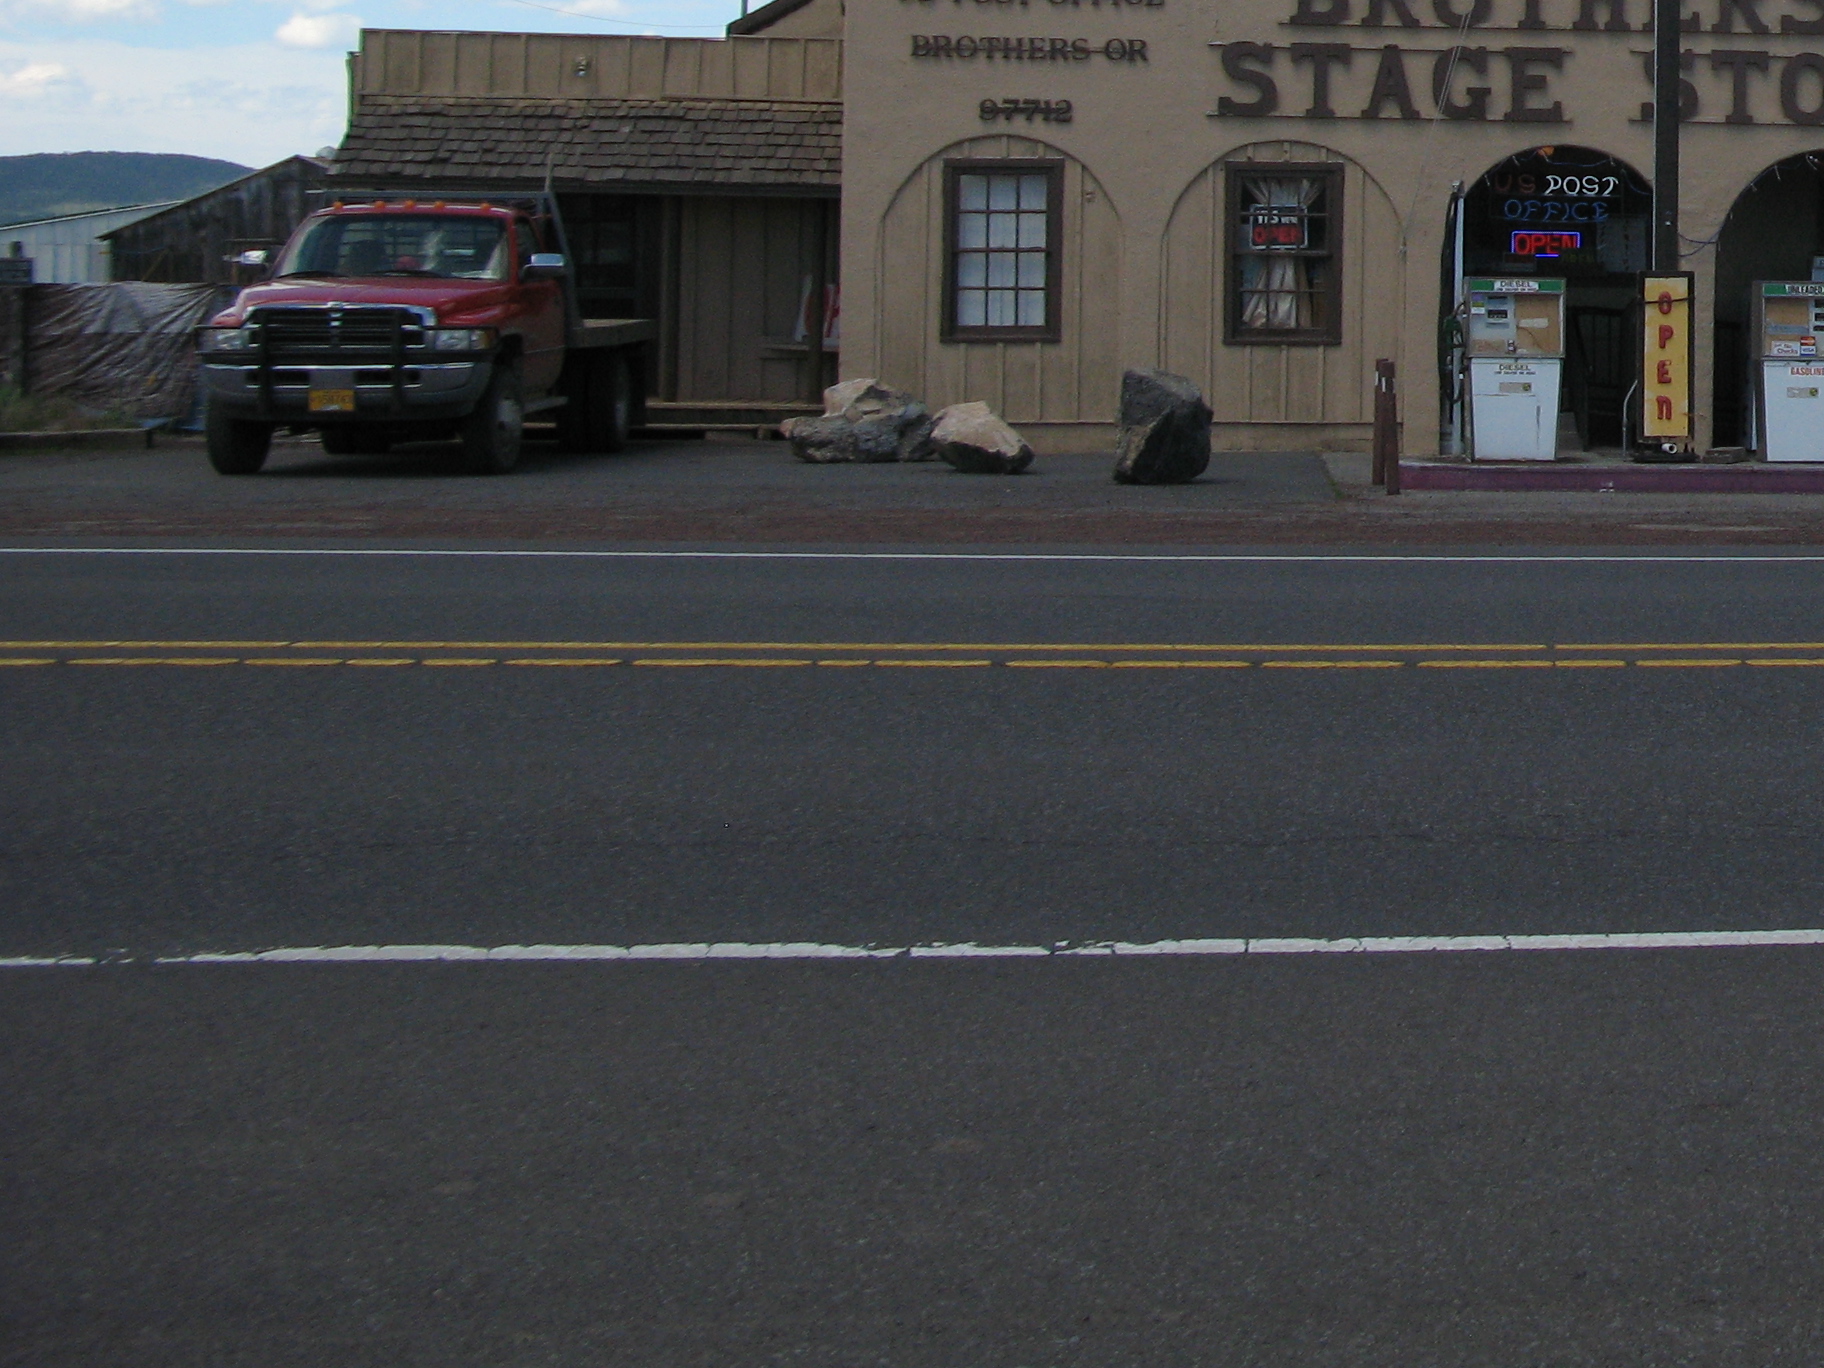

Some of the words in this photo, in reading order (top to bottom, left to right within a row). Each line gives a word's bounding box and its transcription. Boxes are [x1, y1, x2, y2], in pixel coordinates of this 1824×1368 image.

[911, 35, 1091, 62] BROTHERS
[1103, 38, 1148, 62] OR
[1217, 40, 1565, 122] STAGE
[978, 98, 1073, 123] 97712
[1494, 174, 1536, 194] US
[1545, 175, 1619, 196] POST
[1504, 199, 1610, 222] OFFICE
[1514, 233, 1578, 256] OPEN
